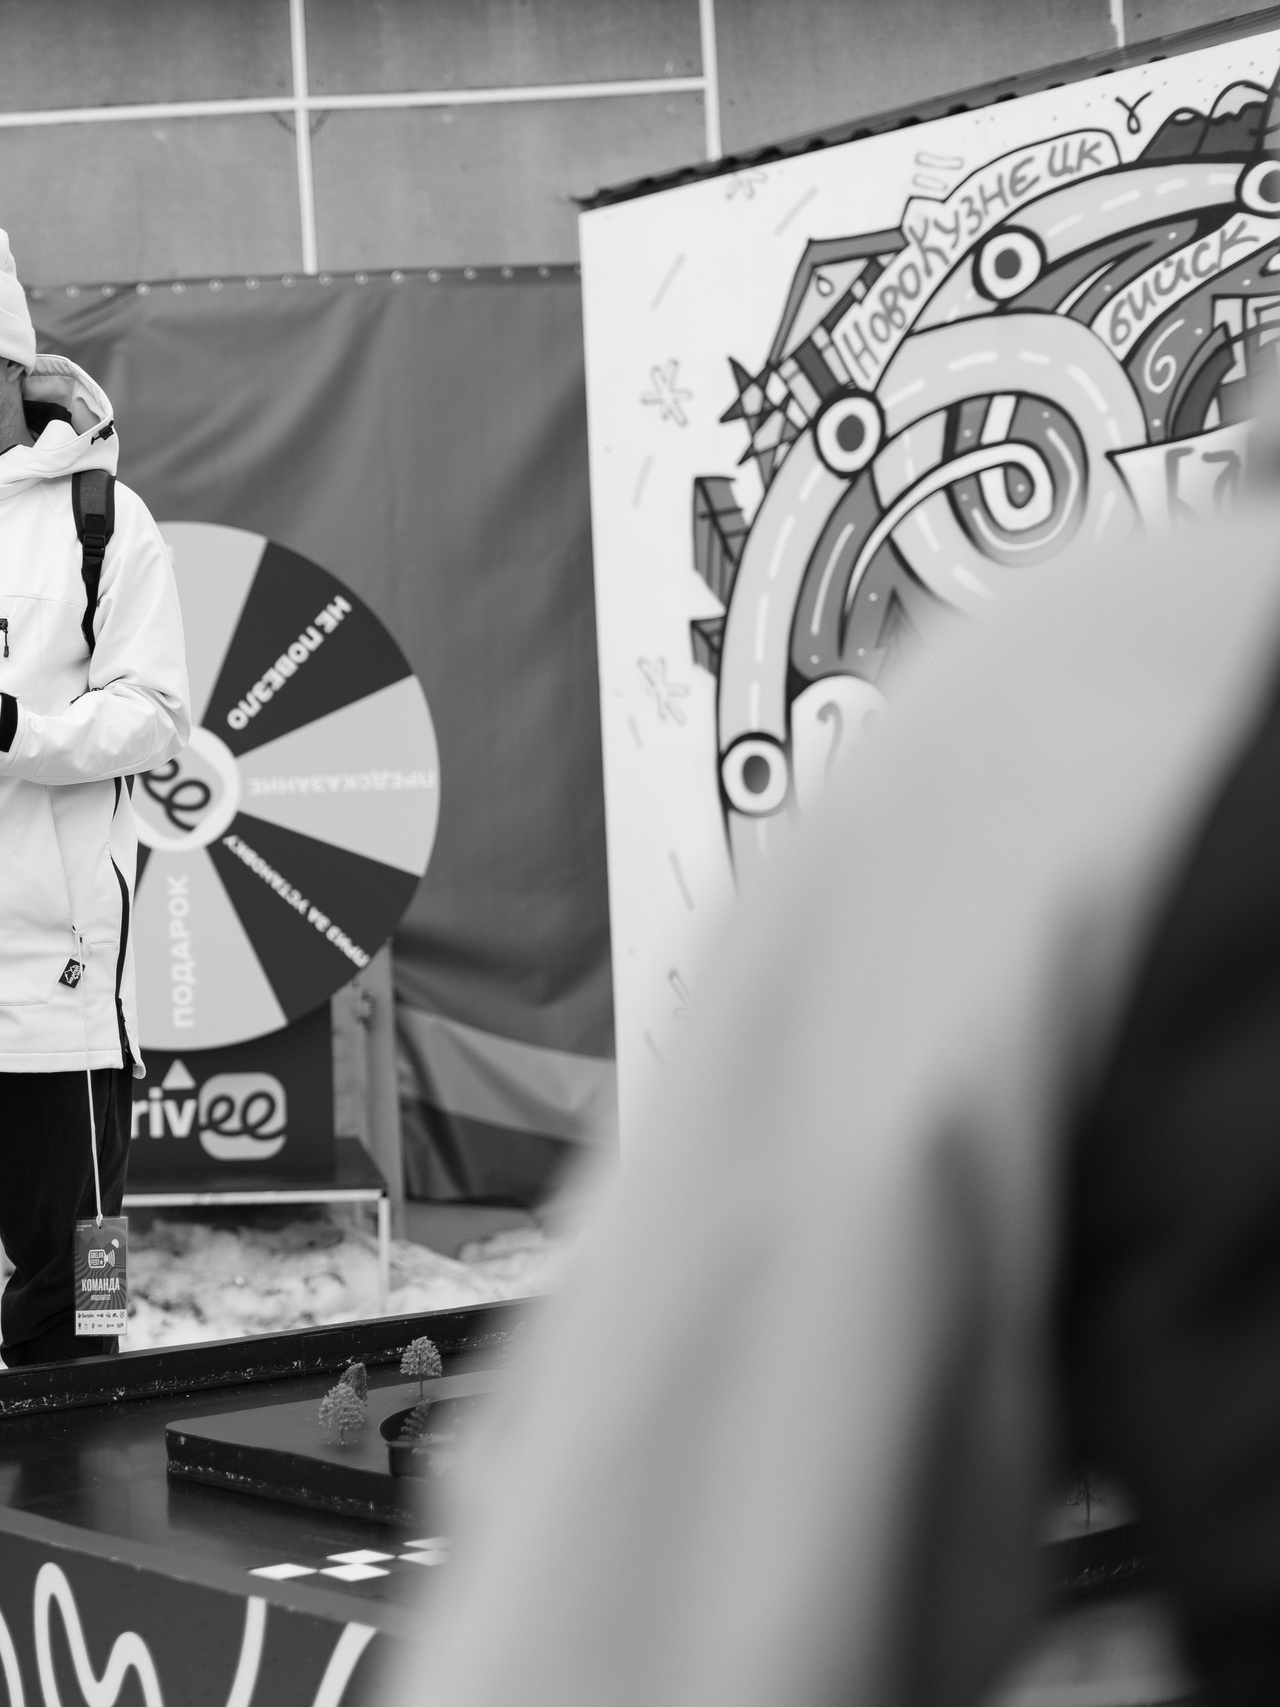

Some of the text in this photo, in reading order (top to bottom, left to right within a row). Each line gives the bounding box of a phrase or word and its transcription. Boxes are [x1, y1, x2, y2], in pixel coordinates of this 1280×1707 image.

[226, 594, 353, 731] НЕ ПОВЕЗЛО
[246, 767, 436, 799] ПРЕДСКАЗАНИЕ
[306, 905, 332, 933] ЗА
[166, 872, 197, 1030] ПОДАРОК
[130, 1085, 287, 1142] rivee
[81, 1277, 120, 1294] КОМАНДА
